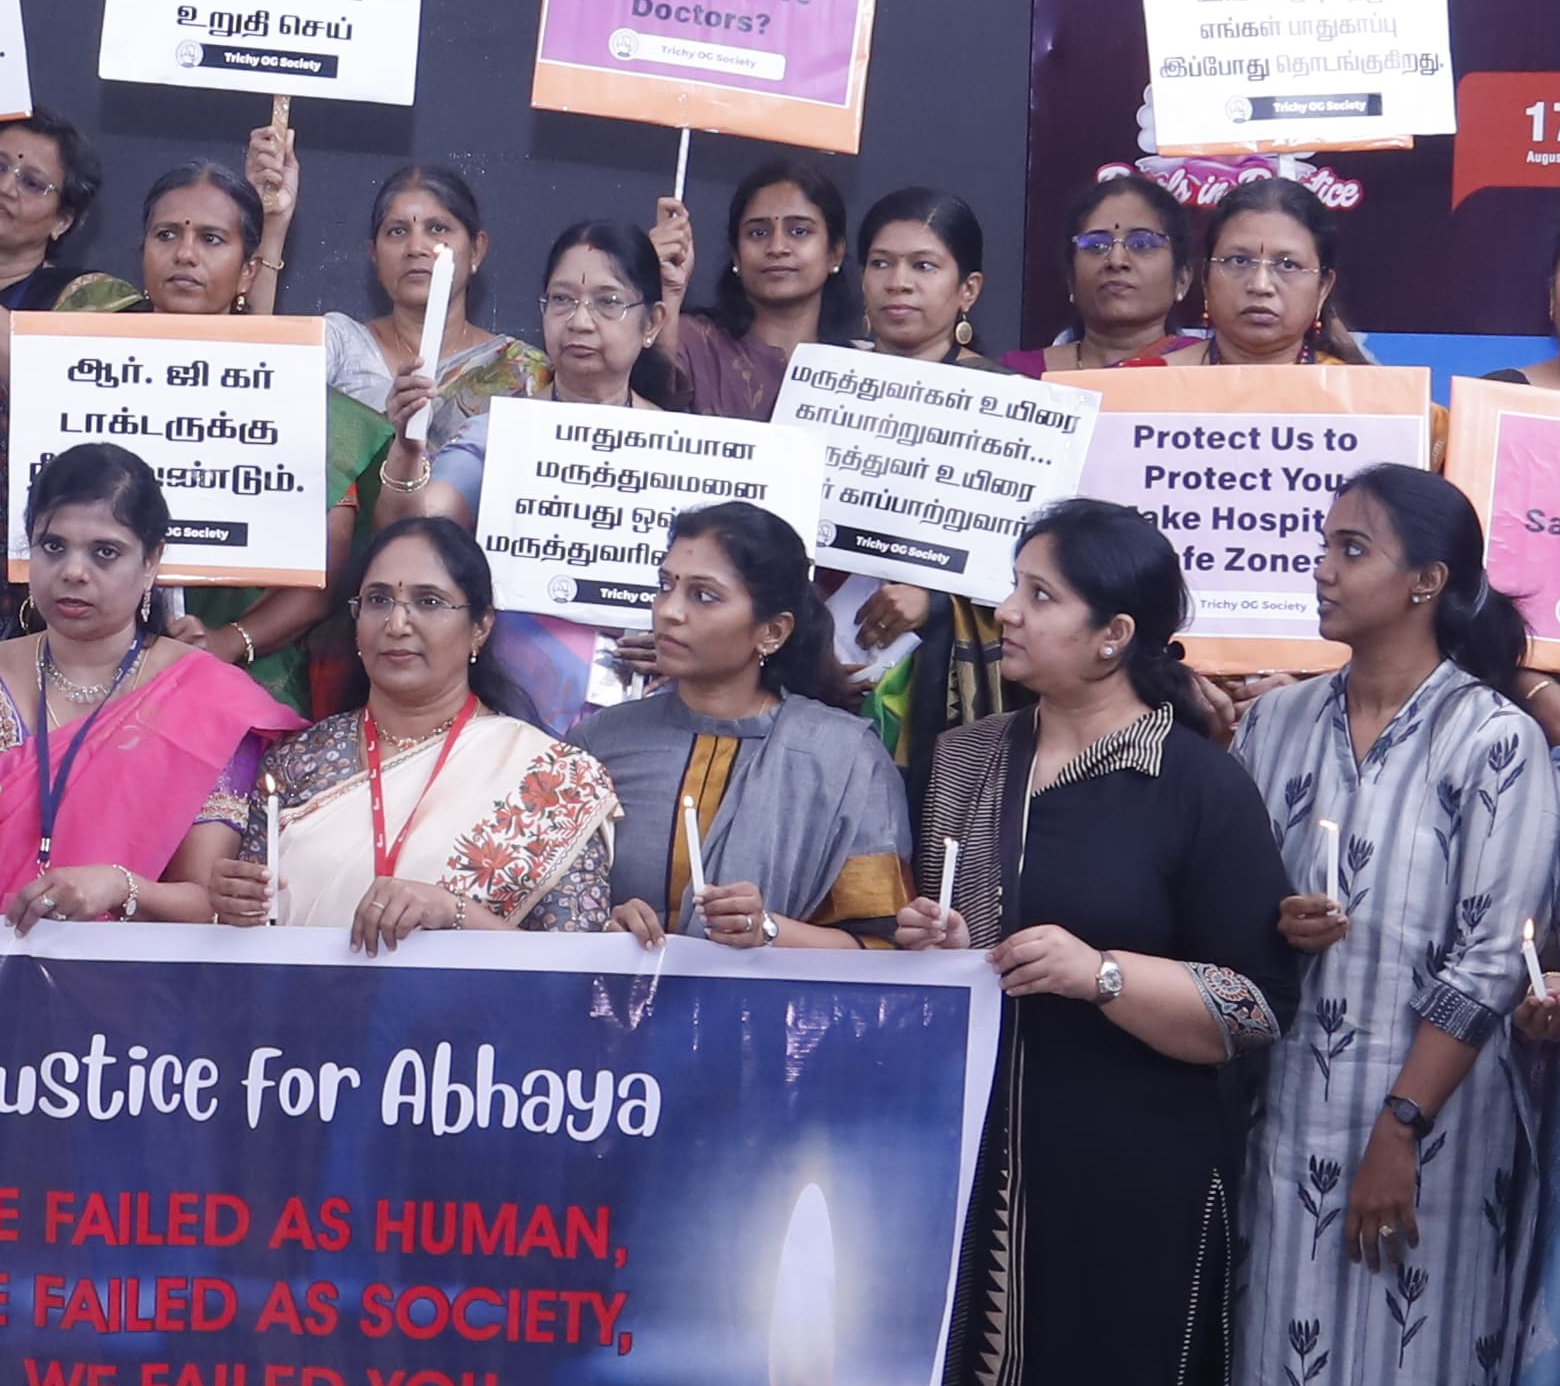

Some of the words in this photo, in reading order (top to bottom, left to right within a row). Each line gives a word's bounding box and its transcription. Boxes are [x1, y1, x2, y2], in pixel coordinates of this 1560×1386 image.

[176, 5, 269, 38] உறுதி
[279, 14, 352, 40] செய்
[68, 356, 152, 388] ஆர்.
[166, 360, 209, 387] ஜி
[221, 362, 275, 389] கர்
[60, 407, 278, 445] டாக்டருக்கு
[1133, 425, 1260, 450] Protect
[1271, 427, 1313, 451] Us
[1324, 429, 1358, 451] to
[242, 1046, 361, 1129] for
[381, 1041, 662, 1142] Abhaya
[45, 1190, 250, 1248] FAILED
[269, 1197, 352, 1252] AS
[375, 1200, 629, 1267] HUMAN,
[34, 1275, 237, 1336] FAILED
[255, 1281, 340, 1338] AS
[359, 1285, 633, 1356] SOCIETY,
